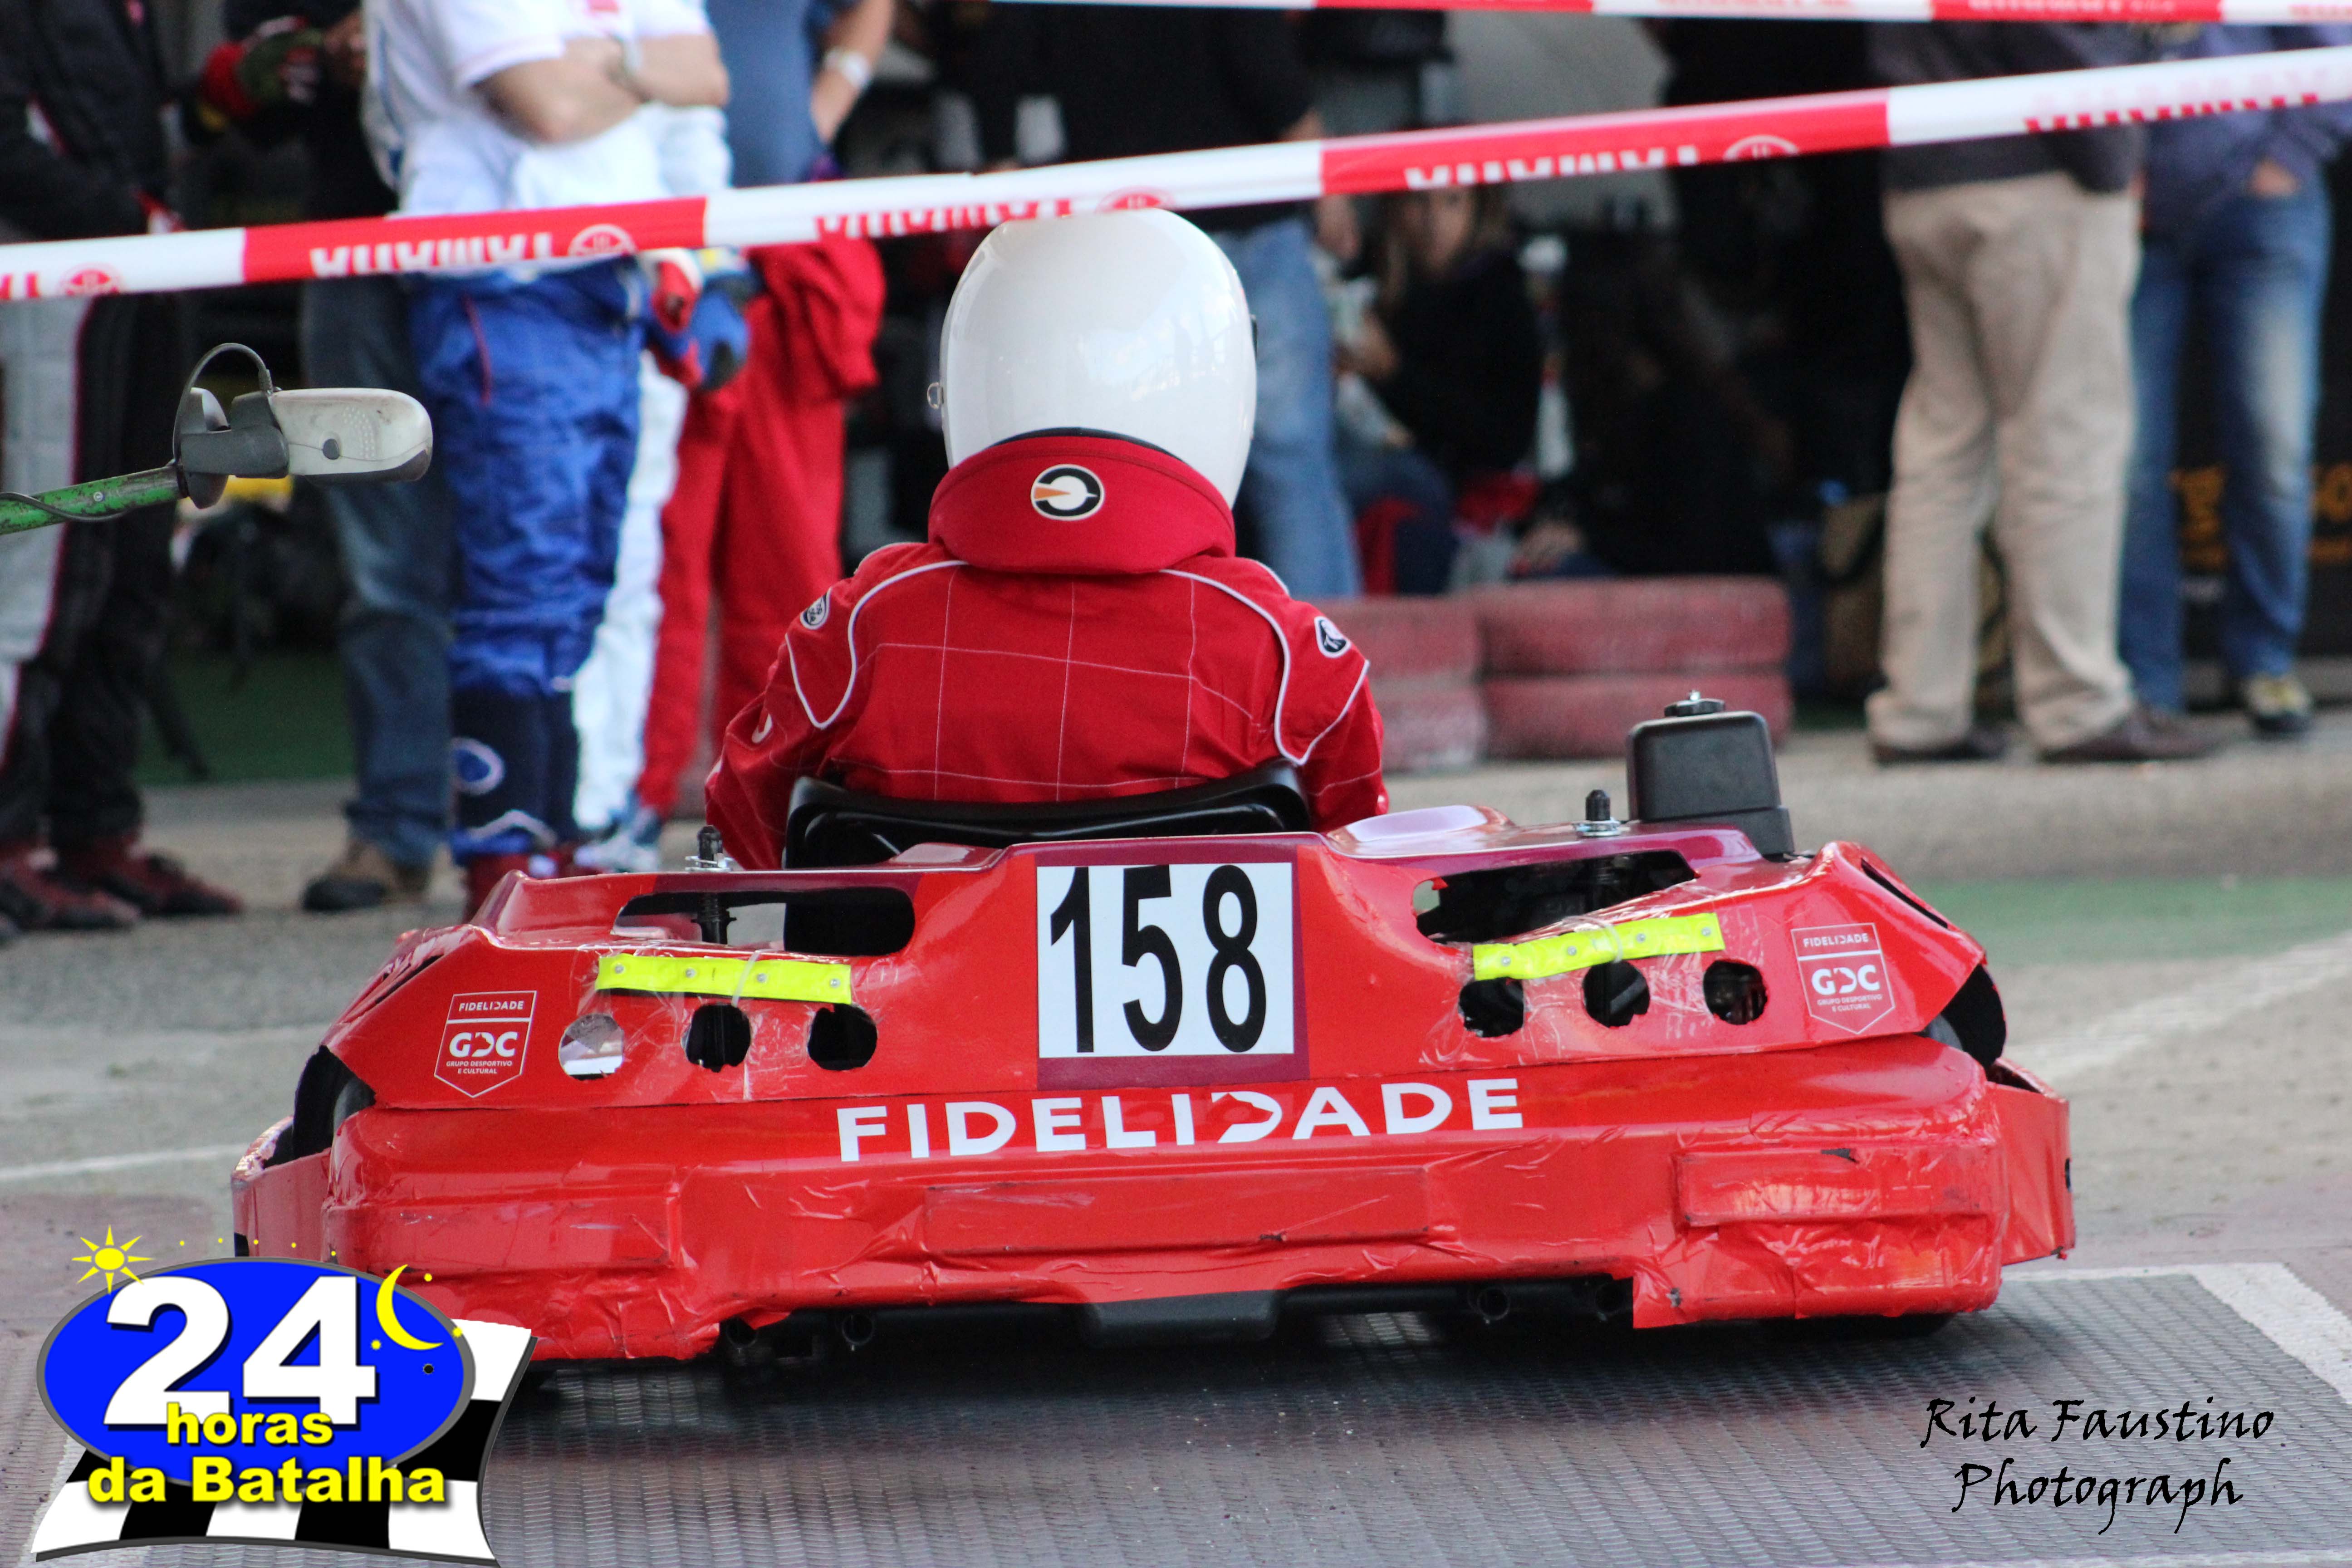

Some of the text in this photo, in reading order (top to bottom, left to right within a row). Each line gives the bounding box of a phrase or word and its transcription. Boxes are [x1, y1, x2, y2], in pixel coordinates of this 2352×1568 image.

[1803, 932, 1869, 947] FIDELIDADE
[1050, 863, 1267, 1053] 158
[1811, 964, 1880, 995] GDC
[458, 1000, 524, 1012] FIDELIDADE
[449, 1031, 518, 1058] GDC
[836, 1078, 1523, 1163] FIDELIDADE
